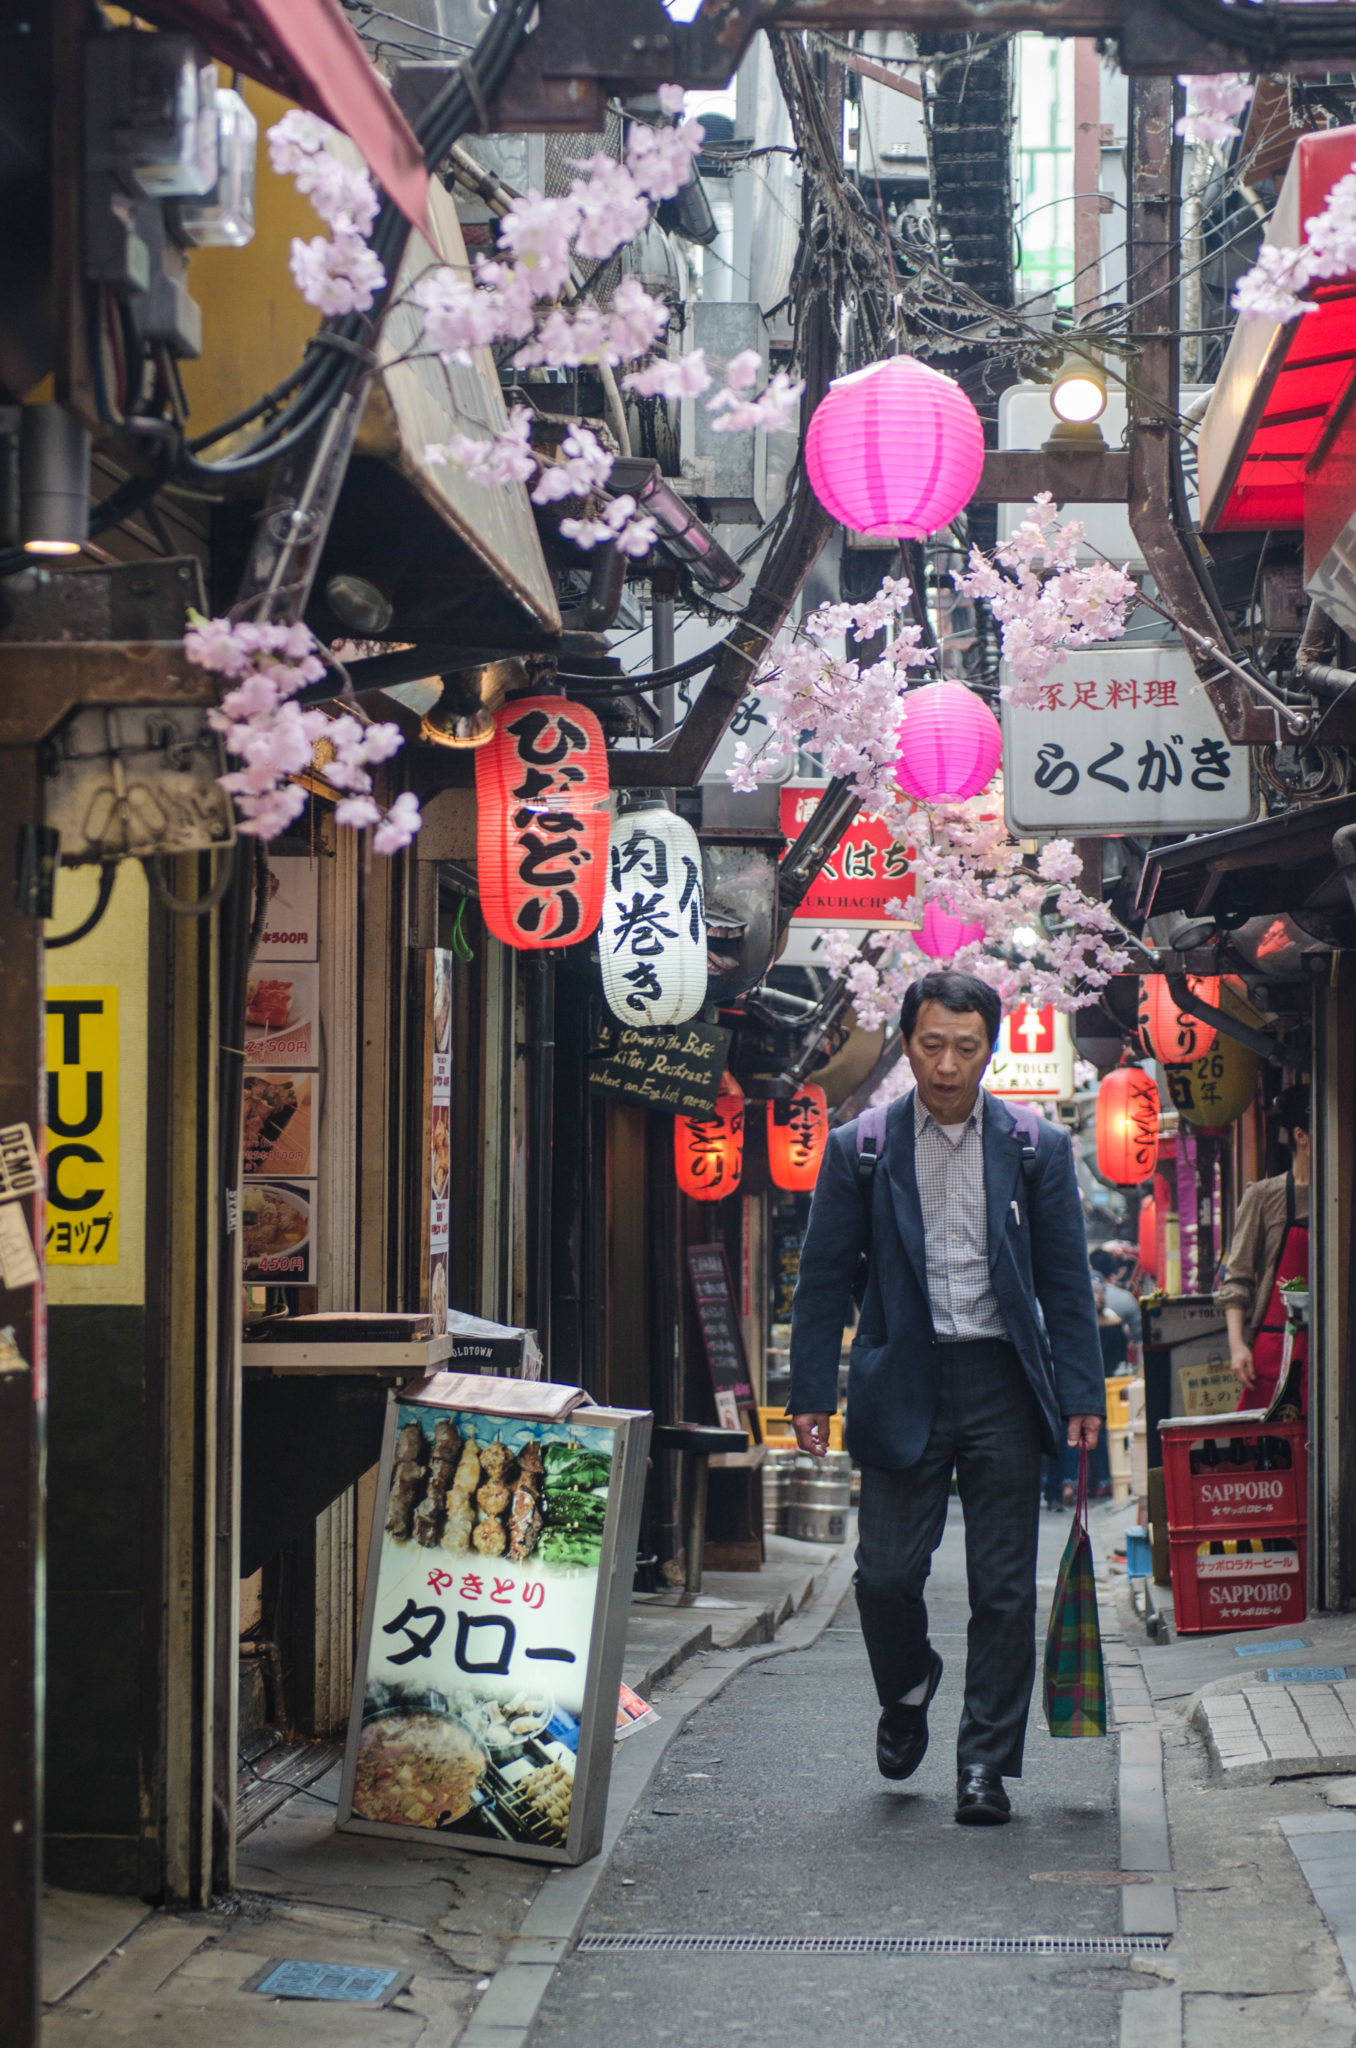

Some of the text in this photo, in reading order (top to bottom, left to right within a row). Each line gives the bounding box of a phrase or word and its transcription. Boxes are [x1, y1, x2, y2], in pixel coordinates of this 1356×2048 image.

[1034, 735, 1231, 795] らくがき
[506, 709, 591, 941] ひなどり
[611, 829, 679, 1012] 肉巻き
[1016, 1063, 1059, 1073] TOILET
[46, 1000, 104, 1212] TUC
[0, 1130, 36, 1190] DEMO
[258, 1257, 305, 1271] 450円
[1201, 1480, 1283, 1503] SAPPORO
[427, 1568, 545, 1609] やきとり
[1197, 1556, 1294, 1573] サッポロラガービール
[1209, 1583, 1291, 1605] SAPPORO
[382, 1598, 576, 1676] タロー
